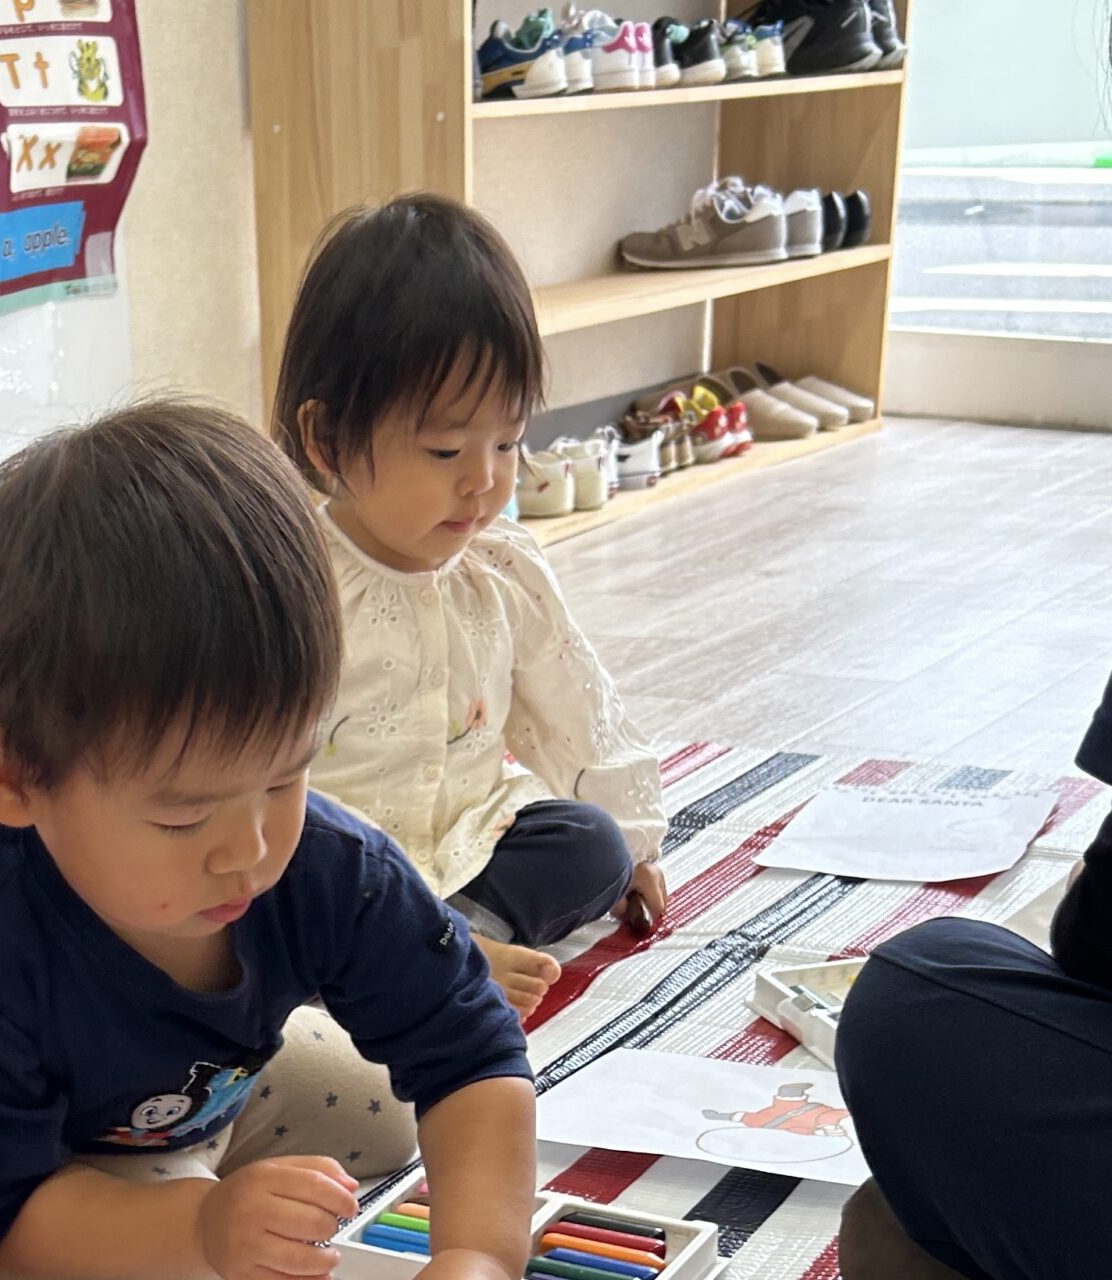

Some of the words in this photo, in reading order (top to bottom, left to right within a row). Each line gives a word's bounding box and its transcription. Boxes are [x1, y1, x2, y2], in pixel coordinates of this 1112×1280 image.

[16, 133, 62, 174] Xx
[862, 796, 913, 805] DEAR
[919, 799, 984, 808] SANTA
